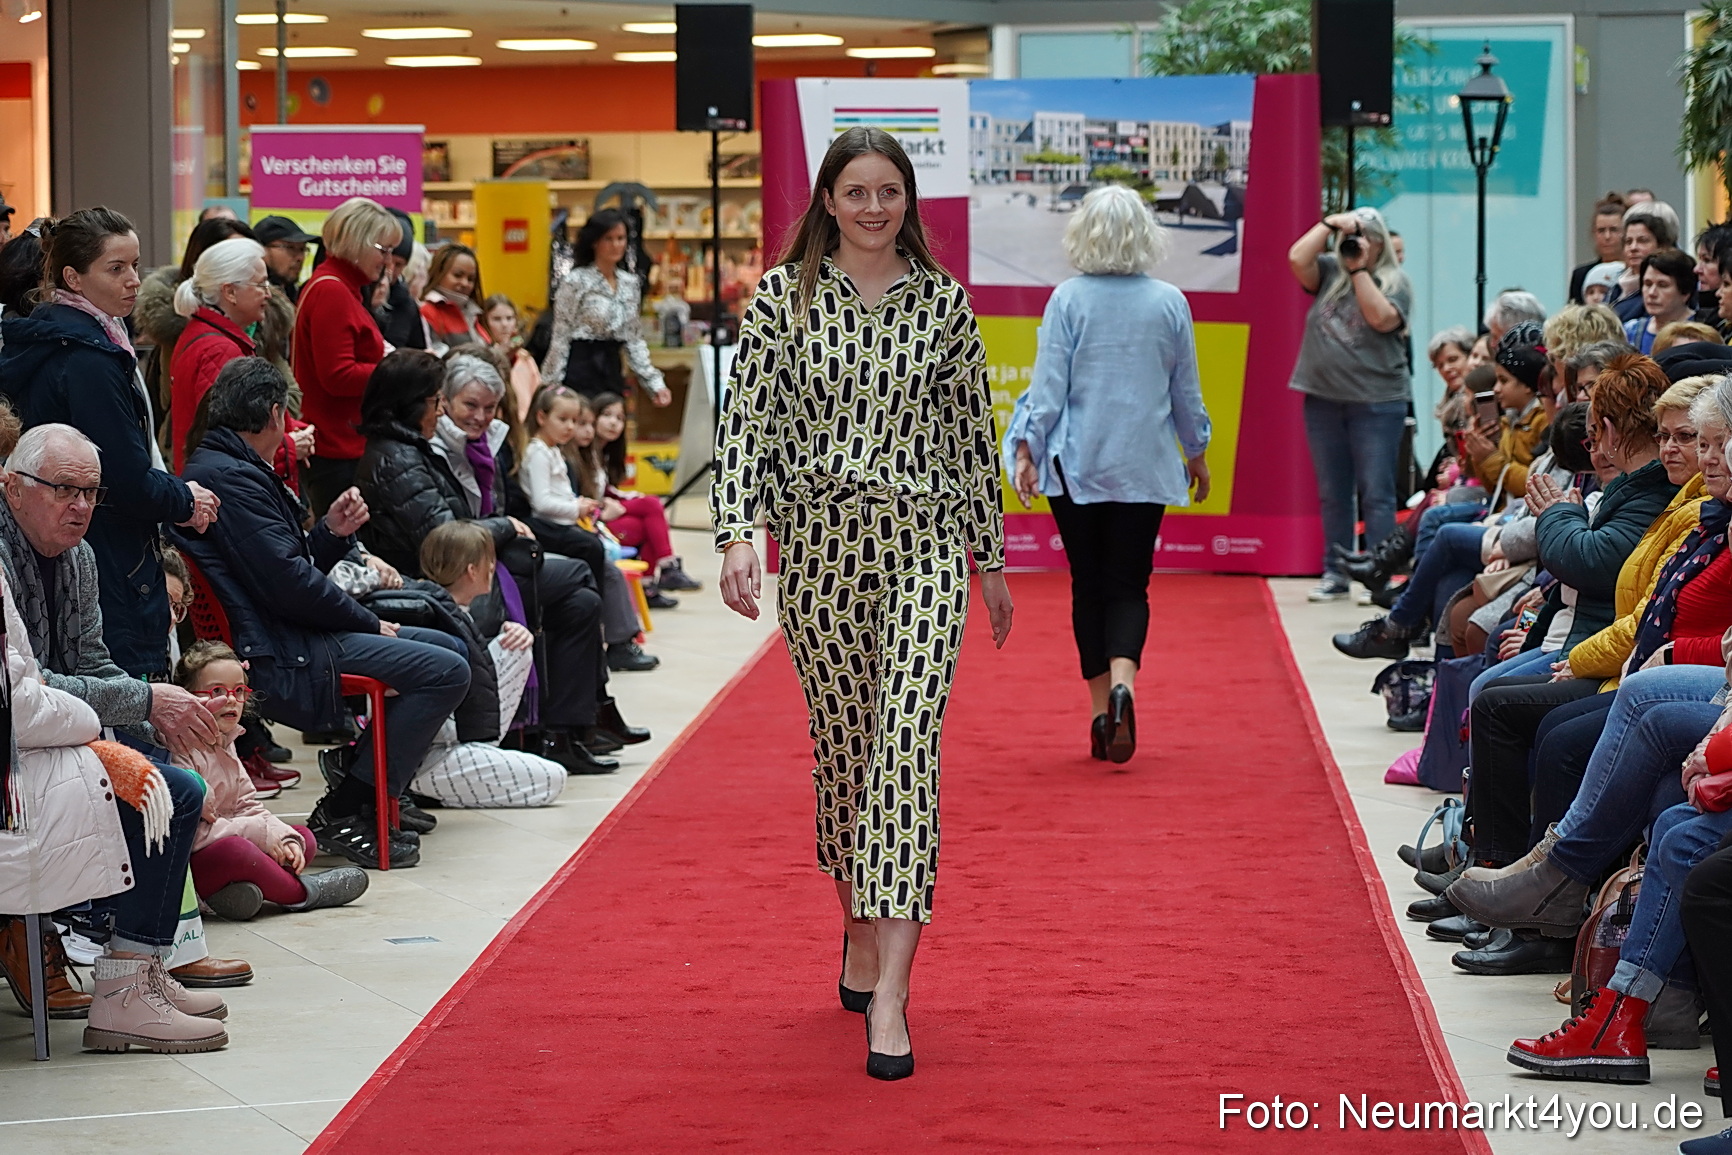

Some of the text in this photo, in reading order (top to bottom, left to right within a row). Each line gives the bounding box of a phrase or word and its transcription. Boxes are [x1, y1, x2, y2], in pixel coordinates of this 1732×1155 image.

[260, 154, 407, 175] Verschenken Sie
[298, 175, 407, 196] Gutscheine!
